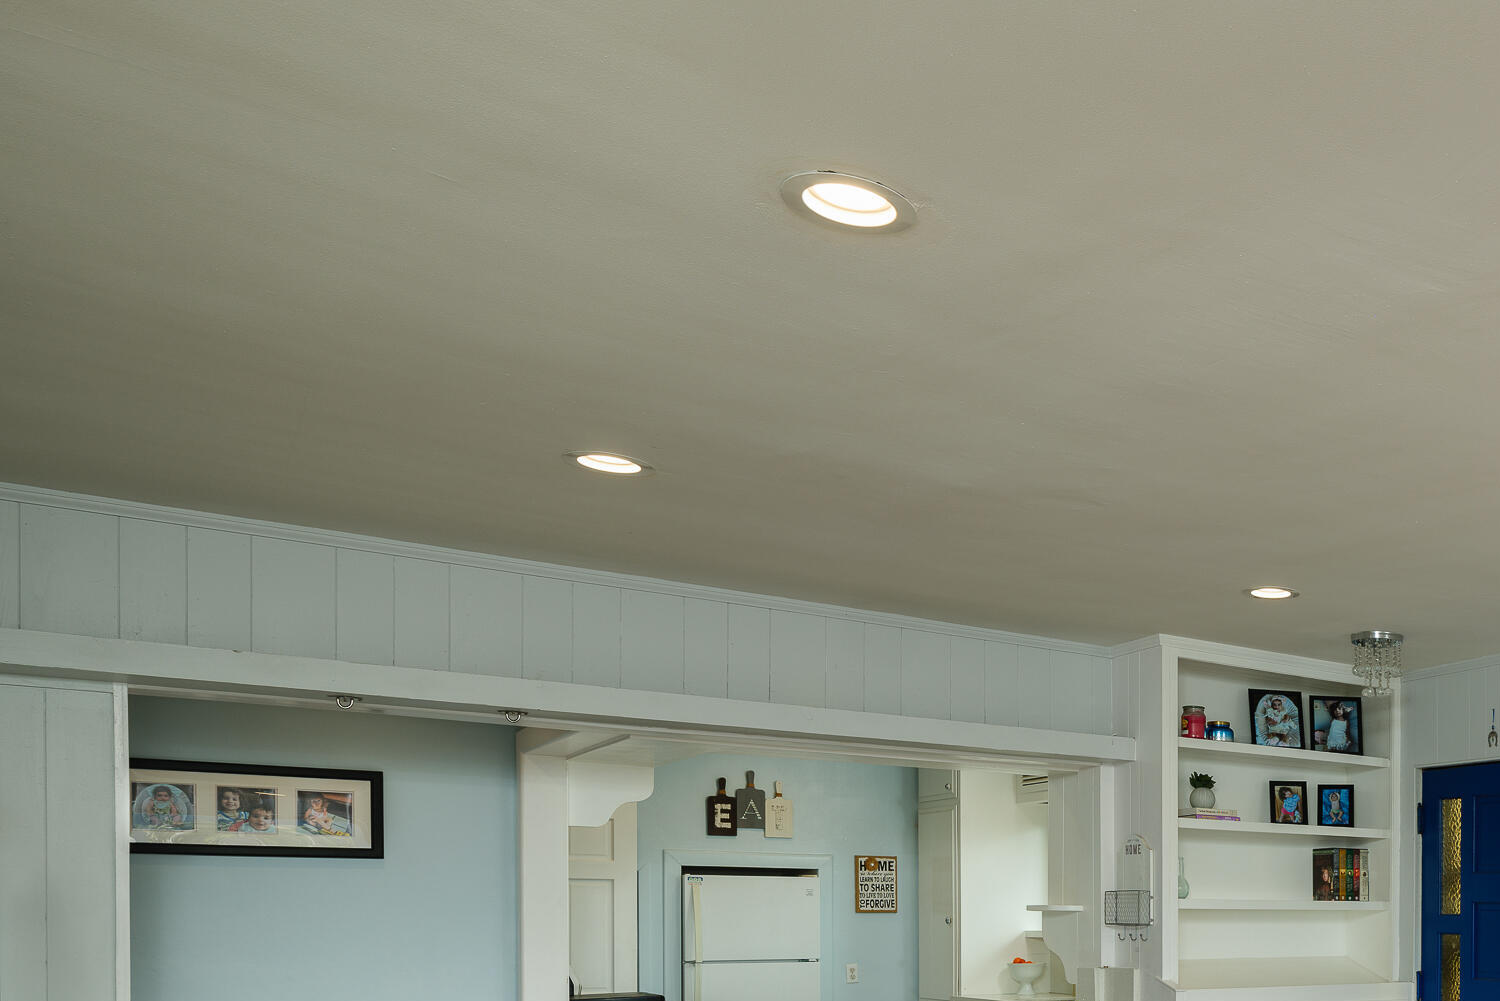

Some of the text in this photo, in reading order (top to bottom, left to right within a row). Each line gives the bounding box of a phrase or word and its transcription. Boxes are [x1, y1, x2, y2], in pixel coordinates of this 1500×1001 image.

[860, 884, 894, 892] TO SHARE
[865, 899, 895, 908] FORGIVE
